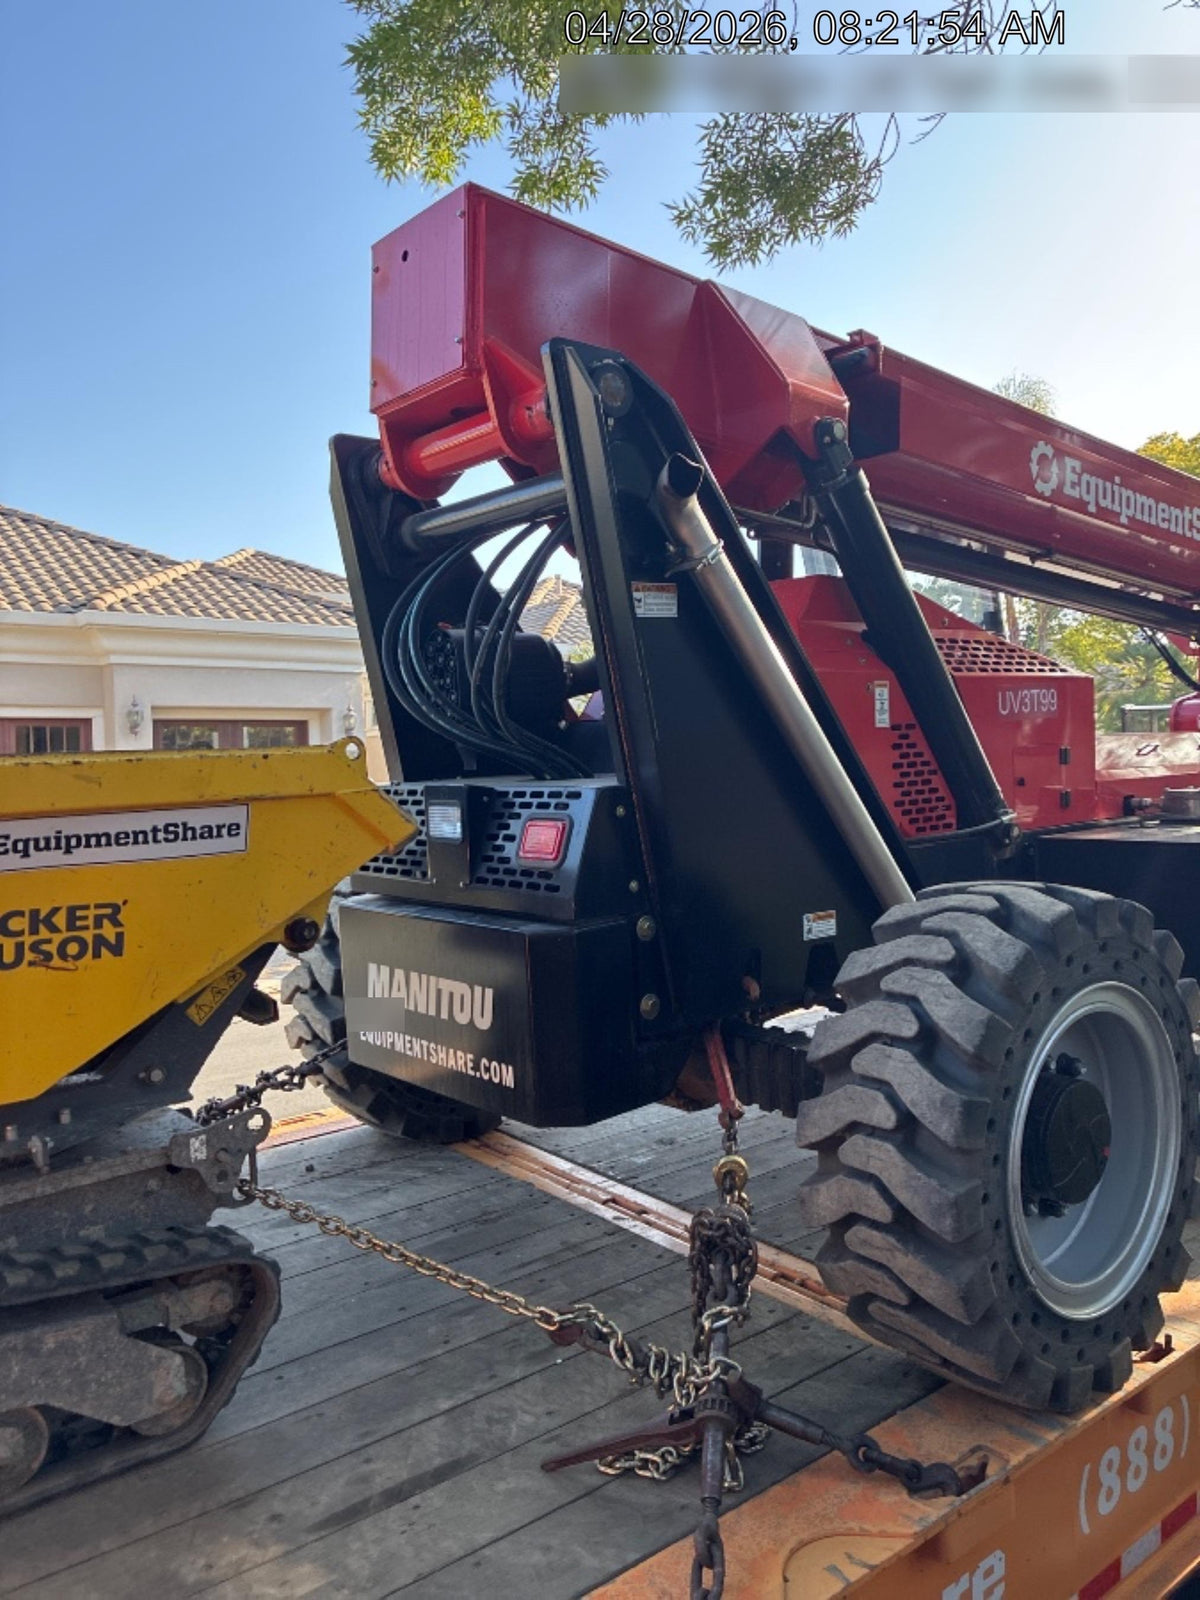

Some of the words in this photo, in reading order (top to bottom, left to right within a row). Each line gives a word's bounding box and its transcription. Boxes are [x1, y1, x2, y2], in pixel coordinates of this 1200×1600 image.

[998, 688, 1057, 715] UV3T99
[0, 902, 125, 938] CKER
[367, 962, 494, 1031] MANITOU
[1079, 1394, 1190, 1535] (888)
